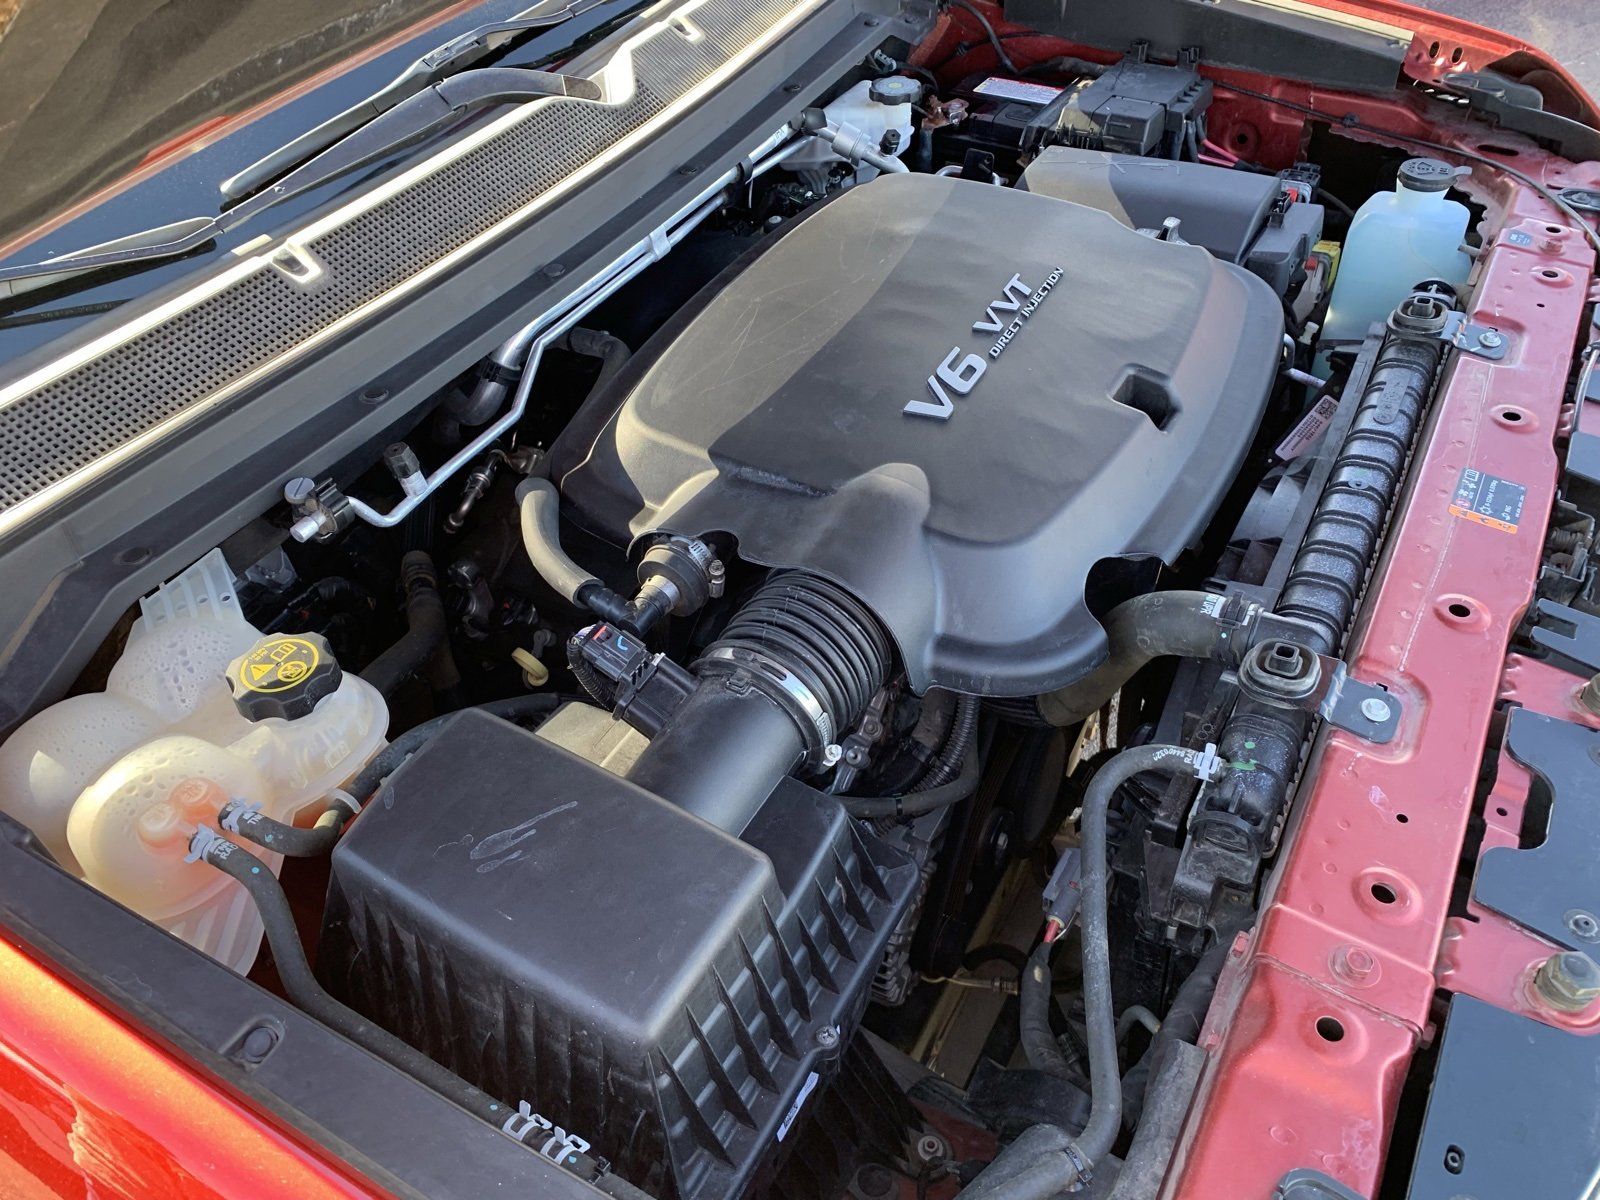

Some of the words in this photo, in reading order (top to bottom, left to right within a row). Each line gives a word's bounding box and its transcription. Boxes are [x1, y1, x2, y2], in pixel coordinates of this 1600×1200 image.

[903, 346, 987, 419] V6
[972, 273, 1032, 332] VVT
[989, 317, 1023, 359] DIRECT
[1021, 267, 1064, 318] INJECTION
